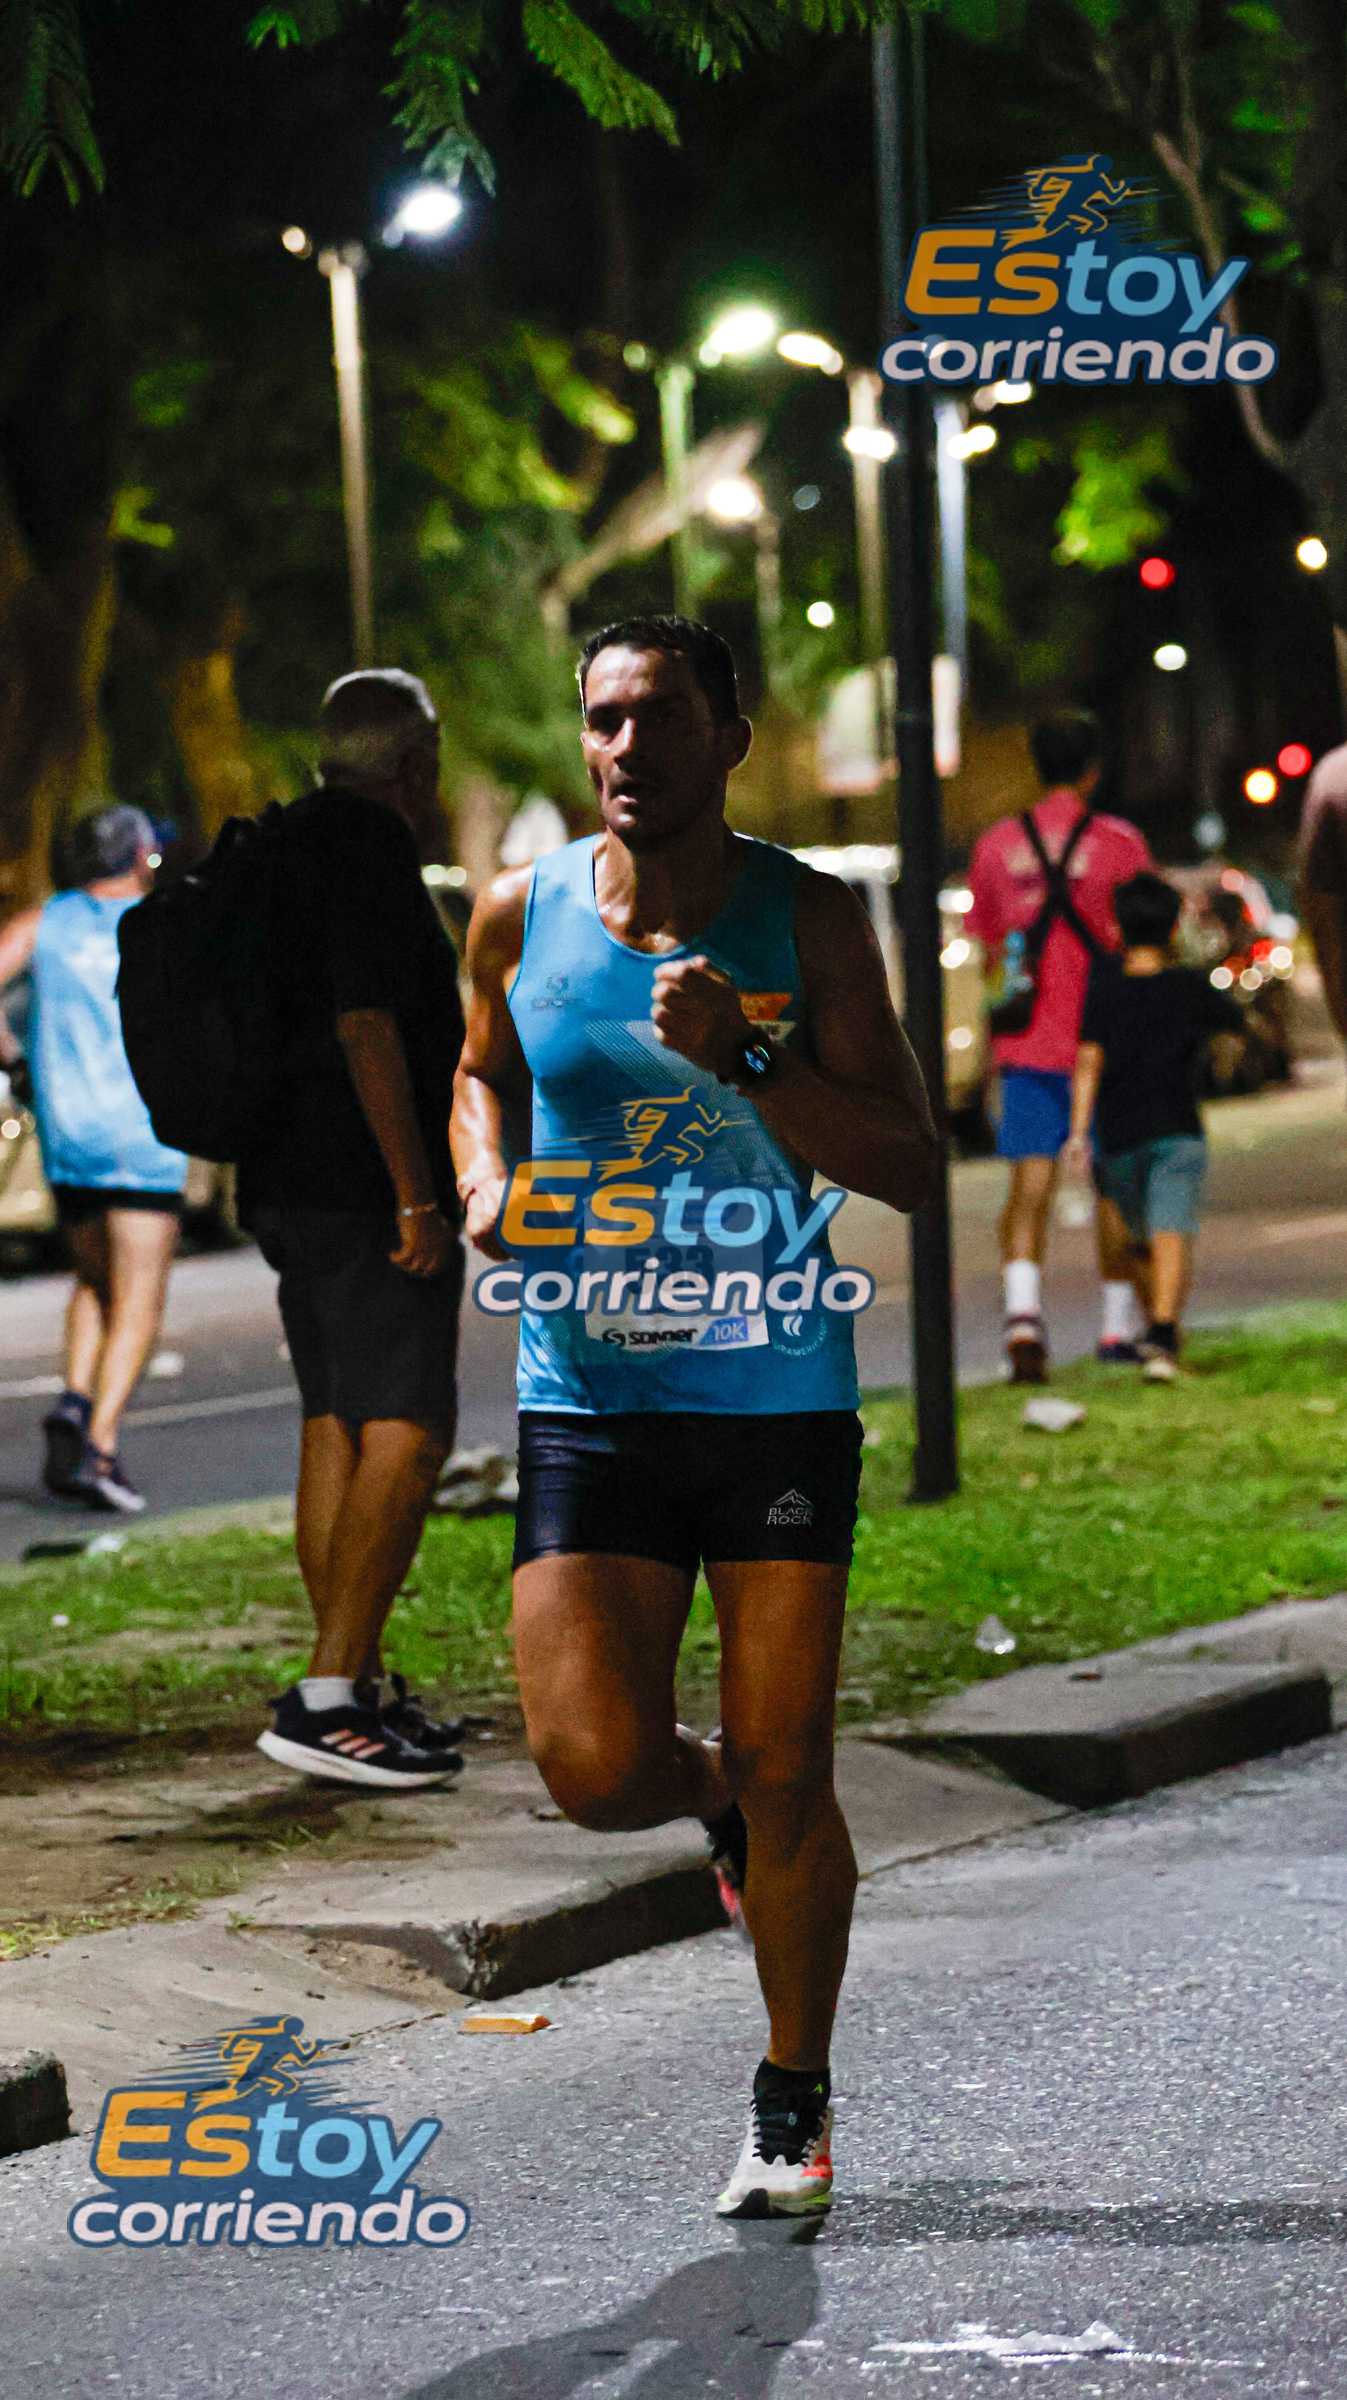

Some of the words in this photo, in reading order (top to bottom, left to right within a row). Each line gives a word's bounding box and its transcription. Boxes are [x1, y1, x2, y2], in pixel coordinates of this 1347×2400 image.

[713, 1320, 745, 1341] 10K
[769, 1507, 813, 1516] BLACK
[767, 1515, 812, 1527] ROCK
